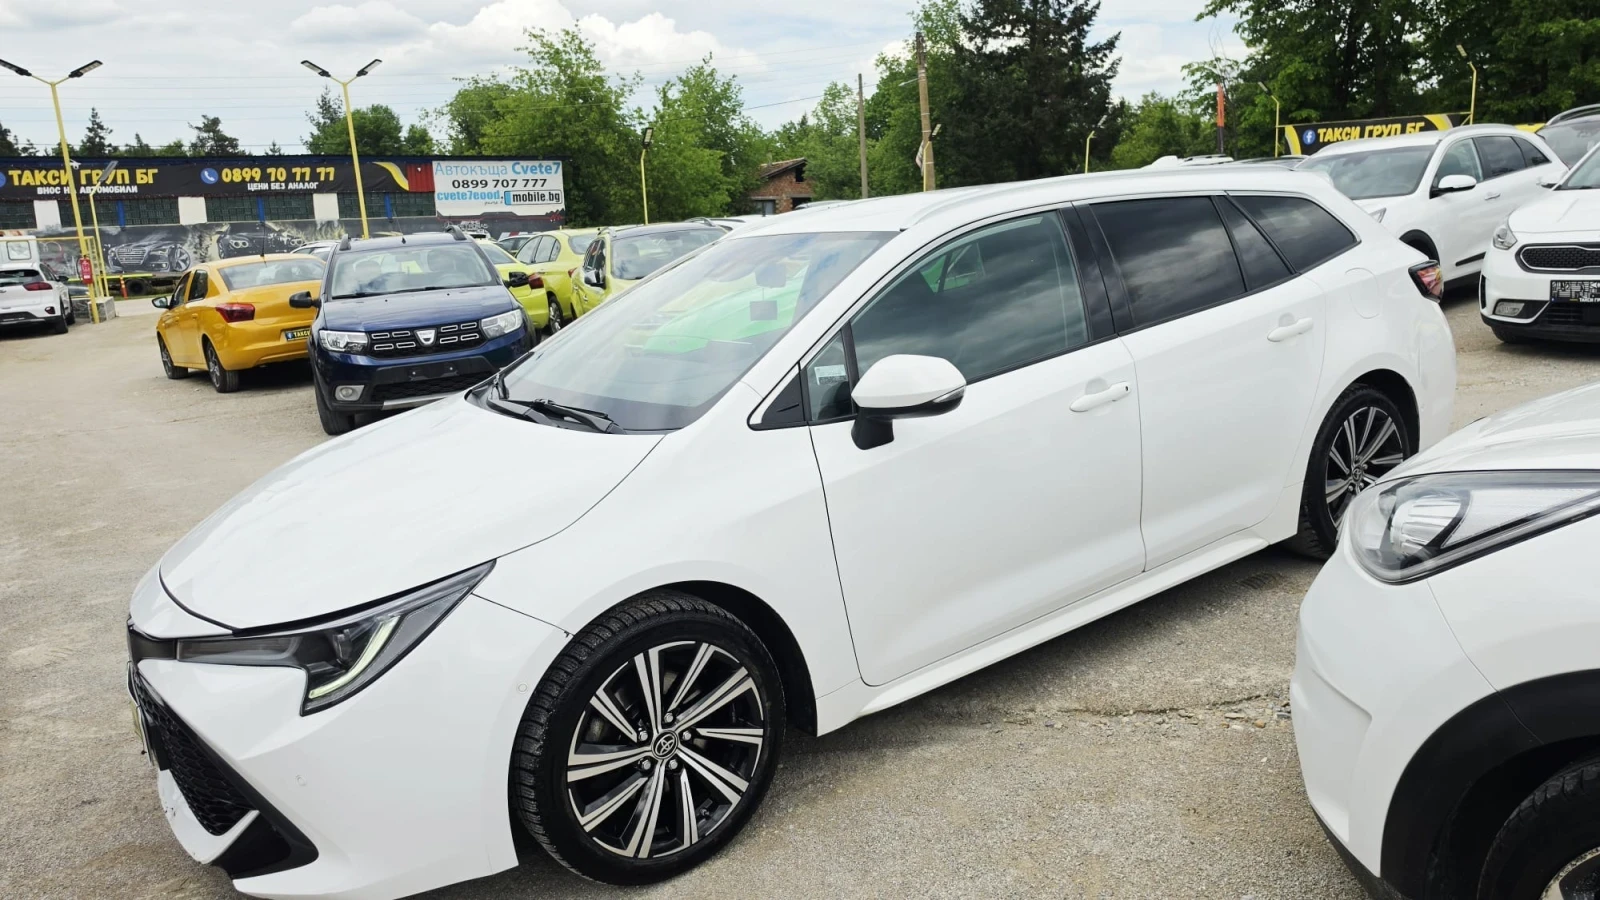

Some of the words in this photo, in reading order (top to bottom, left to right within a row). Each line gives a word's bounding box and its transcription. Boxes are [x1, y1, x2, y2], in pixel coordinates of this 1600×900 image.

[1318, 127, 1360, 142] ТАКСИ
[1364, 124, 1402, 139] ГРУП
[1406, 122, 1425, 133] БГ
[136, 168, 158, 184] БГ
[221, 168, 261, 182] 0899
[266, 167, 287, 182] 70
[292, 167, 311, 181] 77
[316, 167, 335, 181] 77
[435, 162, 508, 177] Автокъща
[511, 162, 561, 174] Cvete7
[247, 183, 269, 191] ЦЕНИ
[270, 182, 286, 190] БЕЗ
[287, 181, 319, 190] АНАЛОГ
[452, 180, 488, 188] 0899
[492, 179, 518, 188] 707
[522, 179, 547, 187] 777
[37, 186, 61, 195] ВНОС
[512, 191, 560, 203] mobile.bg
